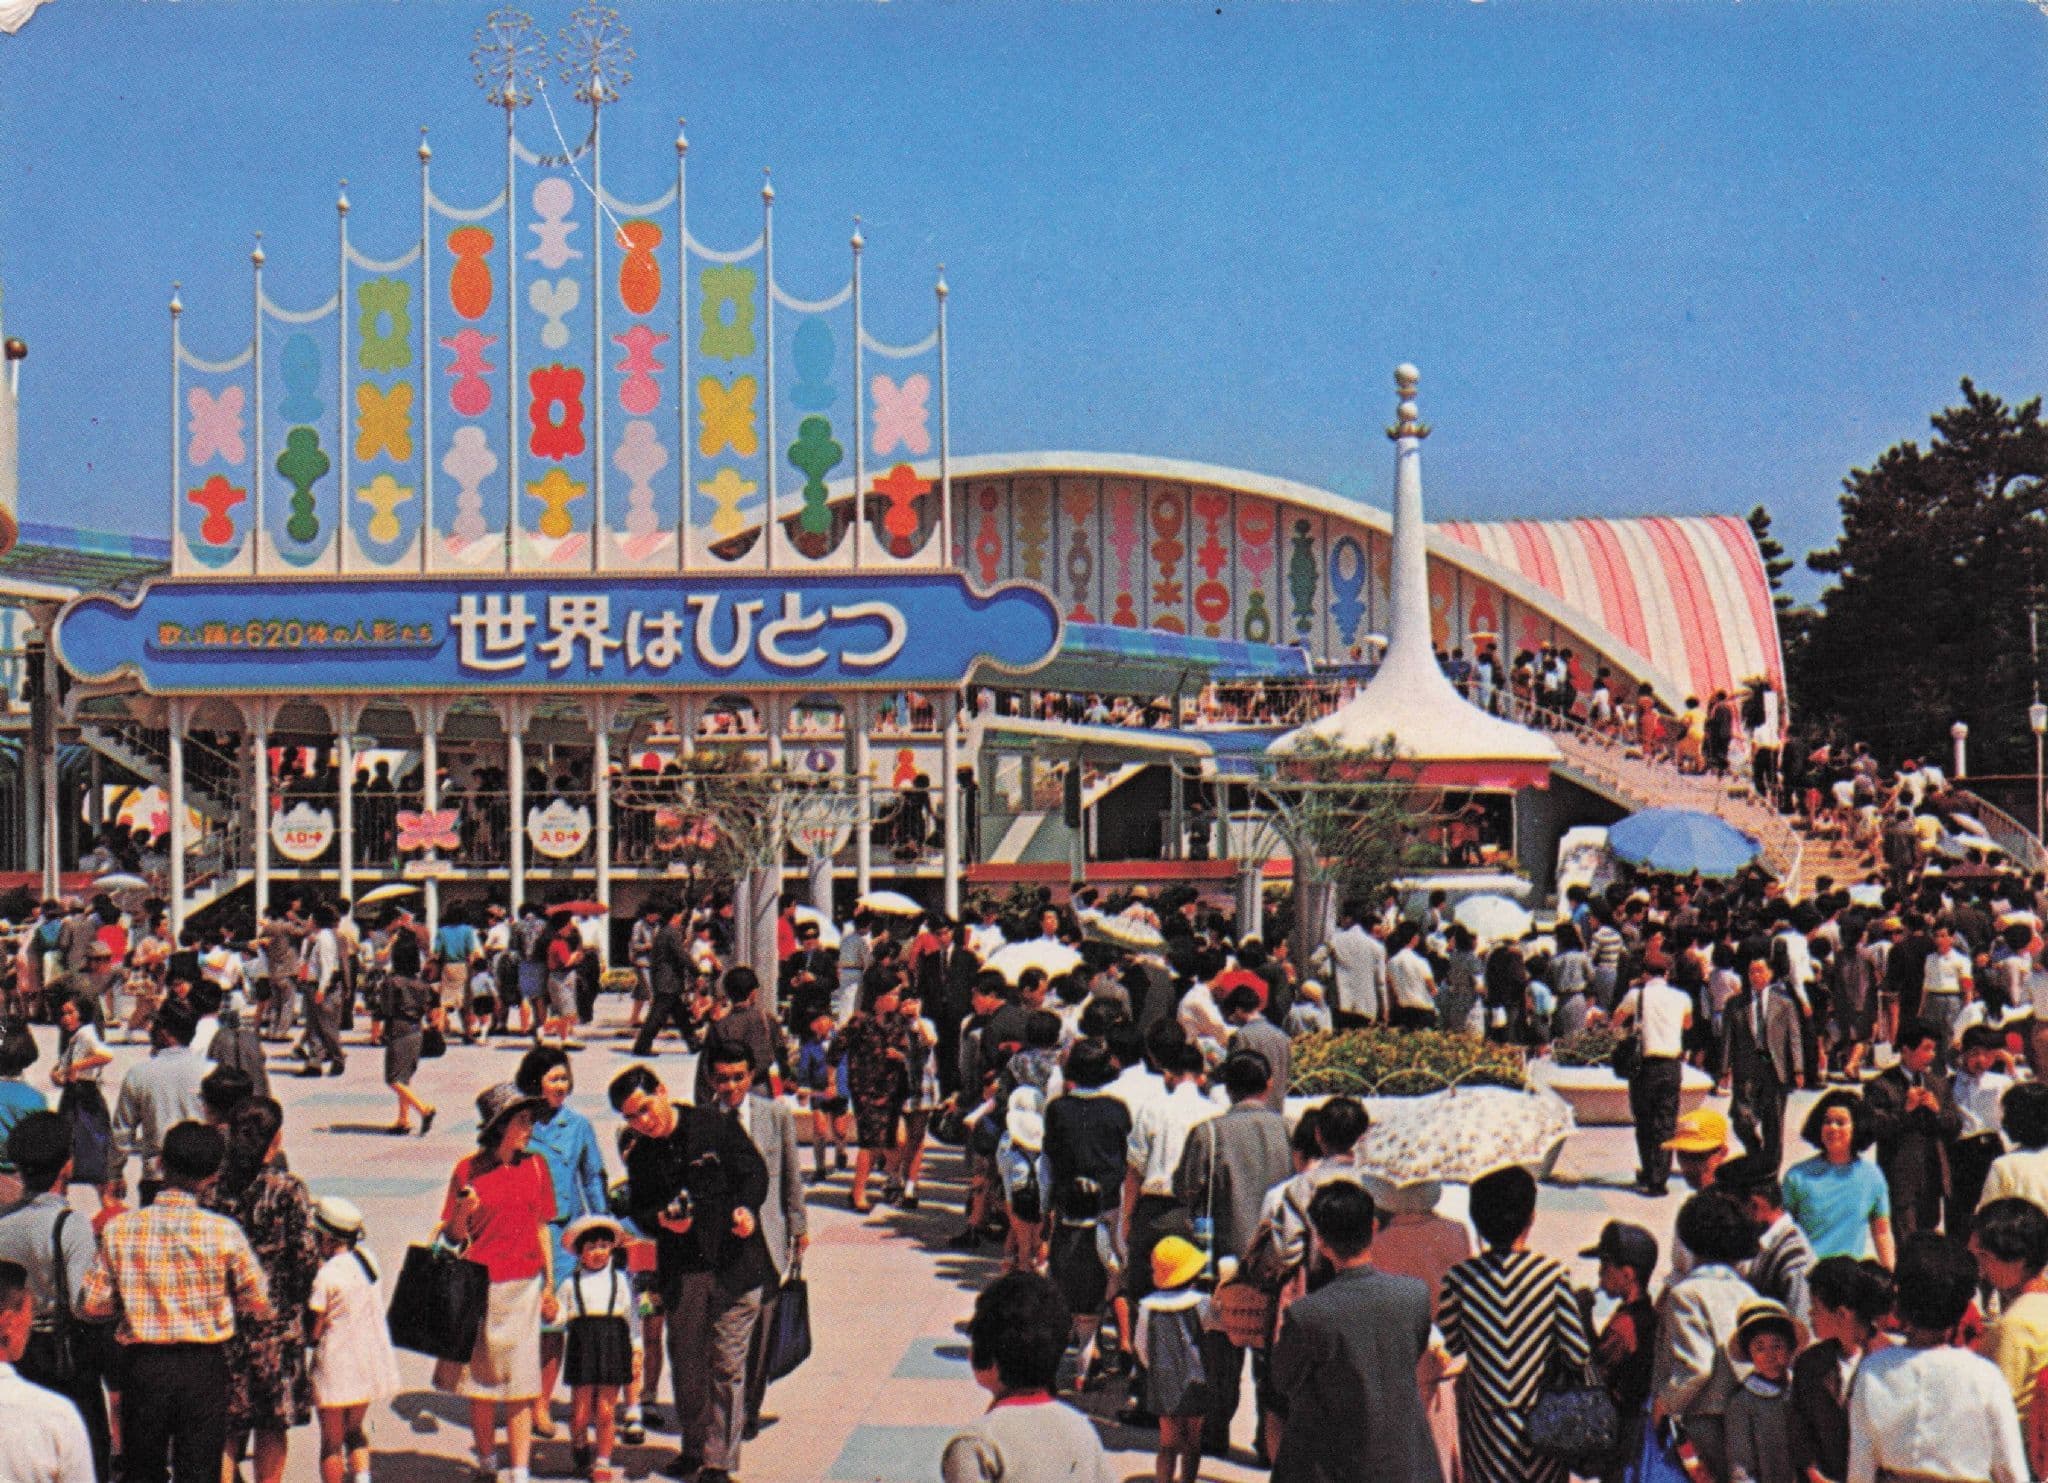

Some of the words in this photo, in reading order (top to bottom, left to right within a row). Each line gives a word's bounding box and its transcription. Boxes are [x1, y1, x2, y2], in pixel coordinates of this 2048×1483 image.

[450, 592, 907, 671] 世界はひとつ
